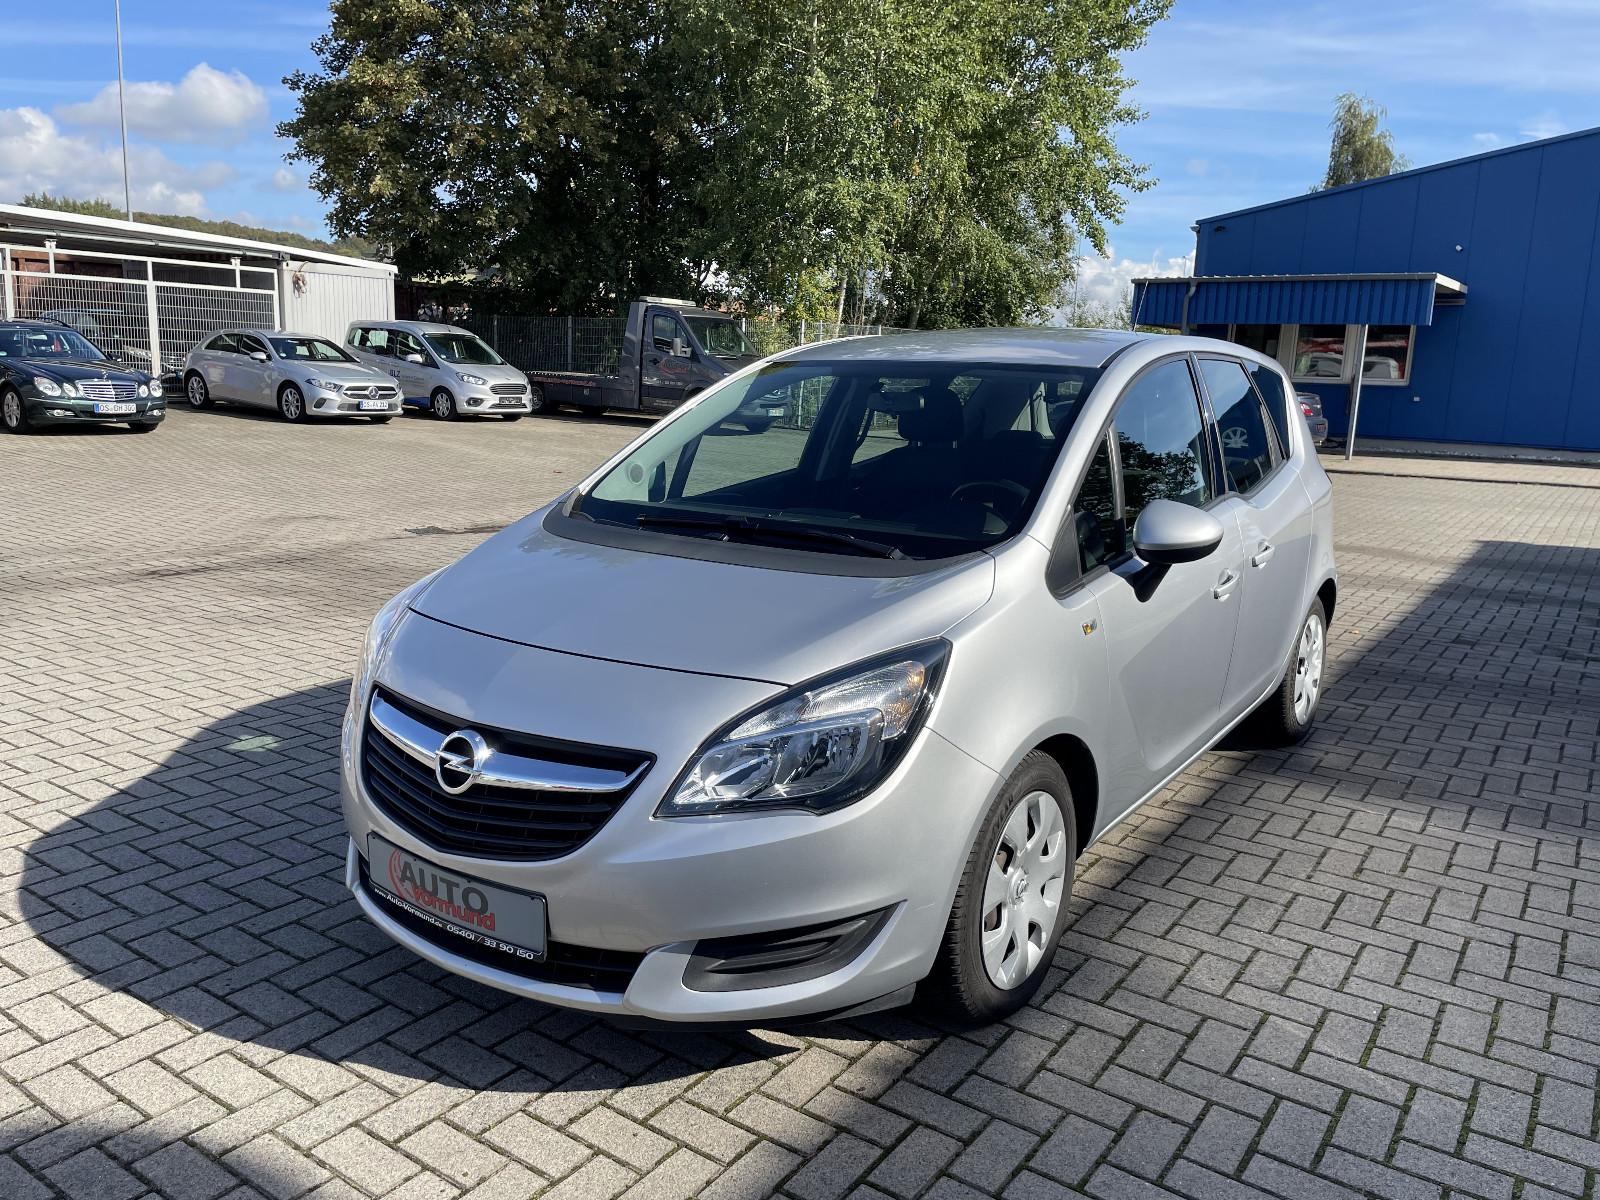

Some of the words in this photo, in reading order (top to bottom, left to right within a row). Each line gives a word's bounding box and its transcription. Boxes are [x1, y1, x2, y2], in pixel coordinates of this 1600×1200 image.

[400, 860, 489, 914] AUTO
[374, 887, 443, 928] www.Auto-Vormund.de
[446, 924, 475, 941] 05401
[483, 937, 497, 948] 33
[499, 943, 514, 954] 90
[516, 948, 534, 960] 150
